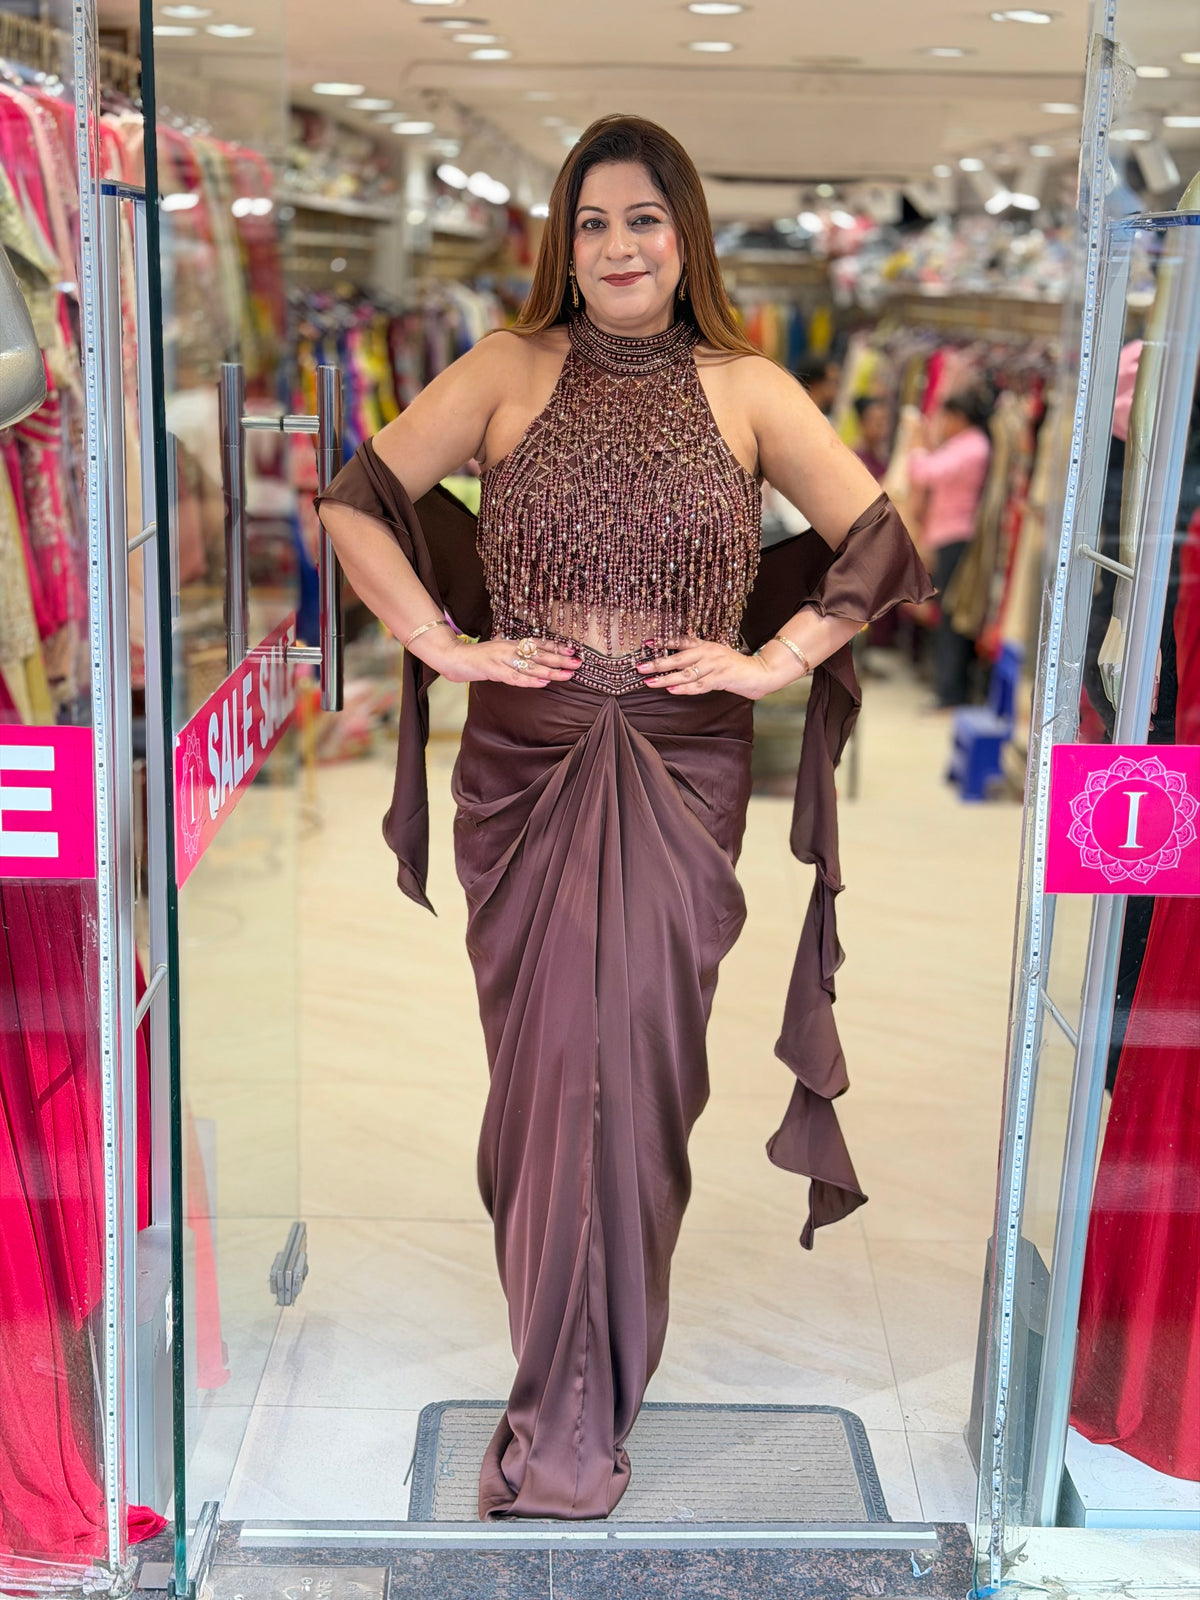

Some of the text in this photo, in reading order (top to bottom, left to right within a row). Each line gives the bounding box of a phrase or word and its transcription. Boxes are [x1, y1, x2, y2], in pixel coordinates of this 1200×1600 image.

[208, 624, 296, 820] SALE SALE
[1118, 791, 1149, 849] I
